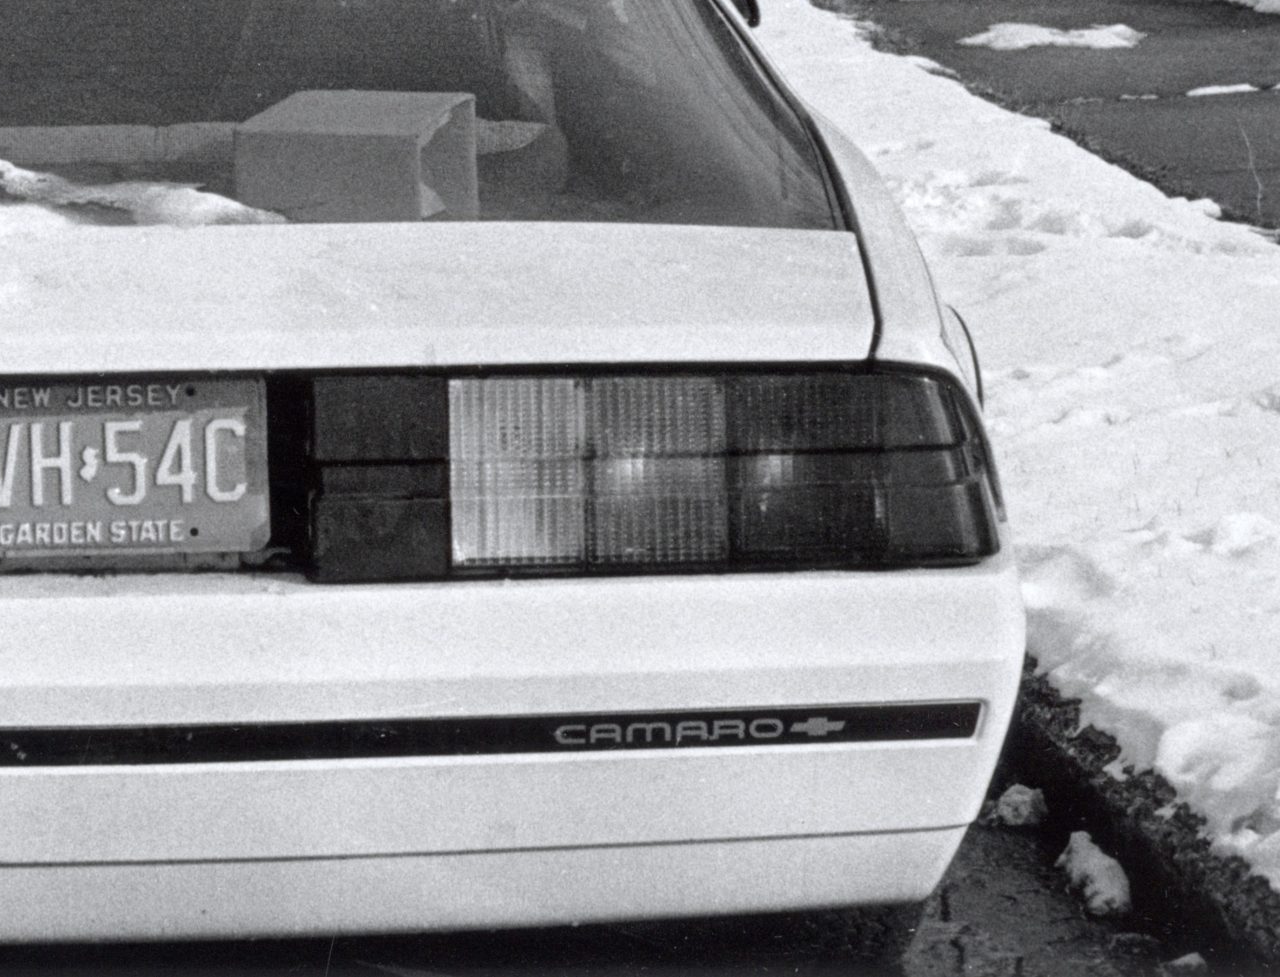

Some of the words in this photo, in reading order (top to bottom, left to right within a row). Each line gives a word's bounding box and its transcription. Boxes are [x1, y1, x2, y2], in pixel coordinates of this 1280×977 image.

[67, 384, 181, 407] JERSEY
[0, 521, 101, 545] GARDEN
[110, 519, 186, 543] STATE
[554, 717, 784, 745] CAMARO
